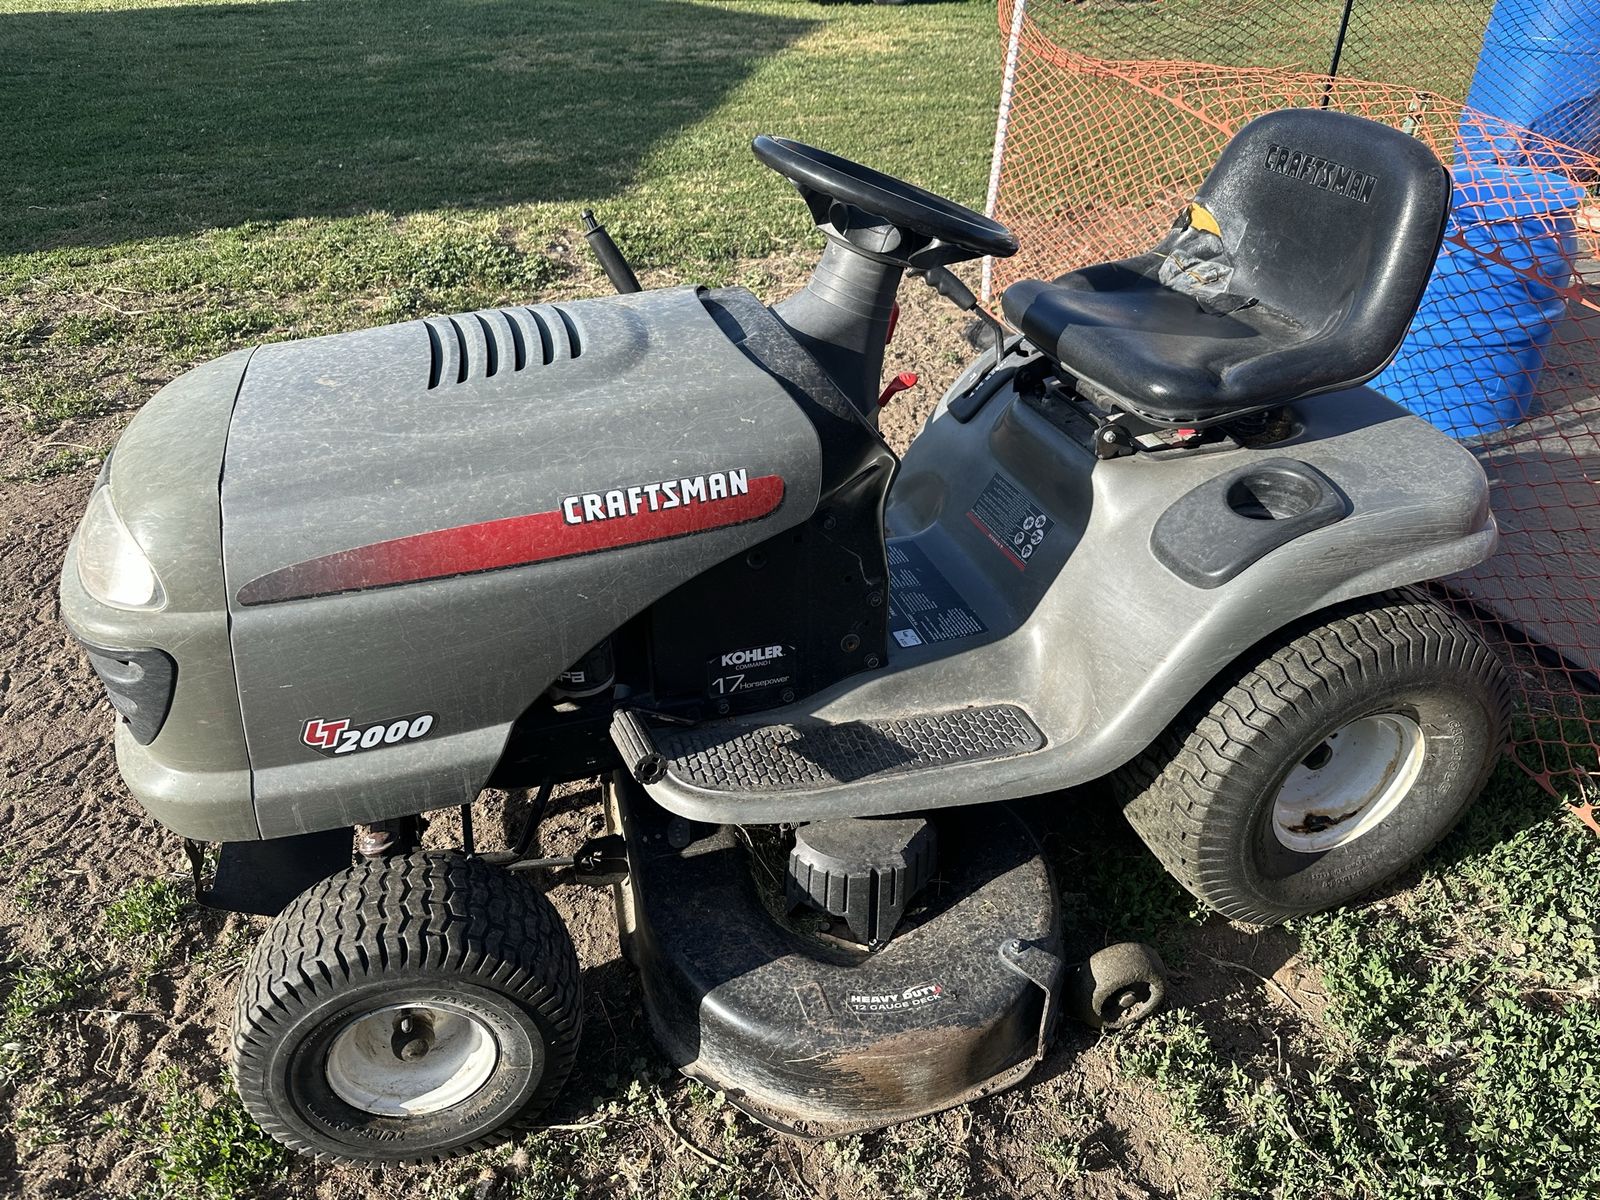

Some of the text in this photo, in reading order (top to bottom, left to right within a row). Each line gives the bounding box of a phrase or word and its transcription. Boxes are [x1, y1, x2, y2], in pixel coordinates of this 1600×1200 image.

[1264, 144, 1378, 204] CRAFTSMAN
[563, 468, 749, 525] CRAFTSMAN
[721, 645, 784, 667] KOHLER
[735, 660, 768, 671] COMMAND
[711, 674, 790, 694] 17 Horsepower
[304, 714, 434, 754] LT 2000
[850, 984, 938, 1004] HEAVY DUTY
[870, 1001, 910, 1011] GAUGE
[912, 993, 942, 1006] DECK
